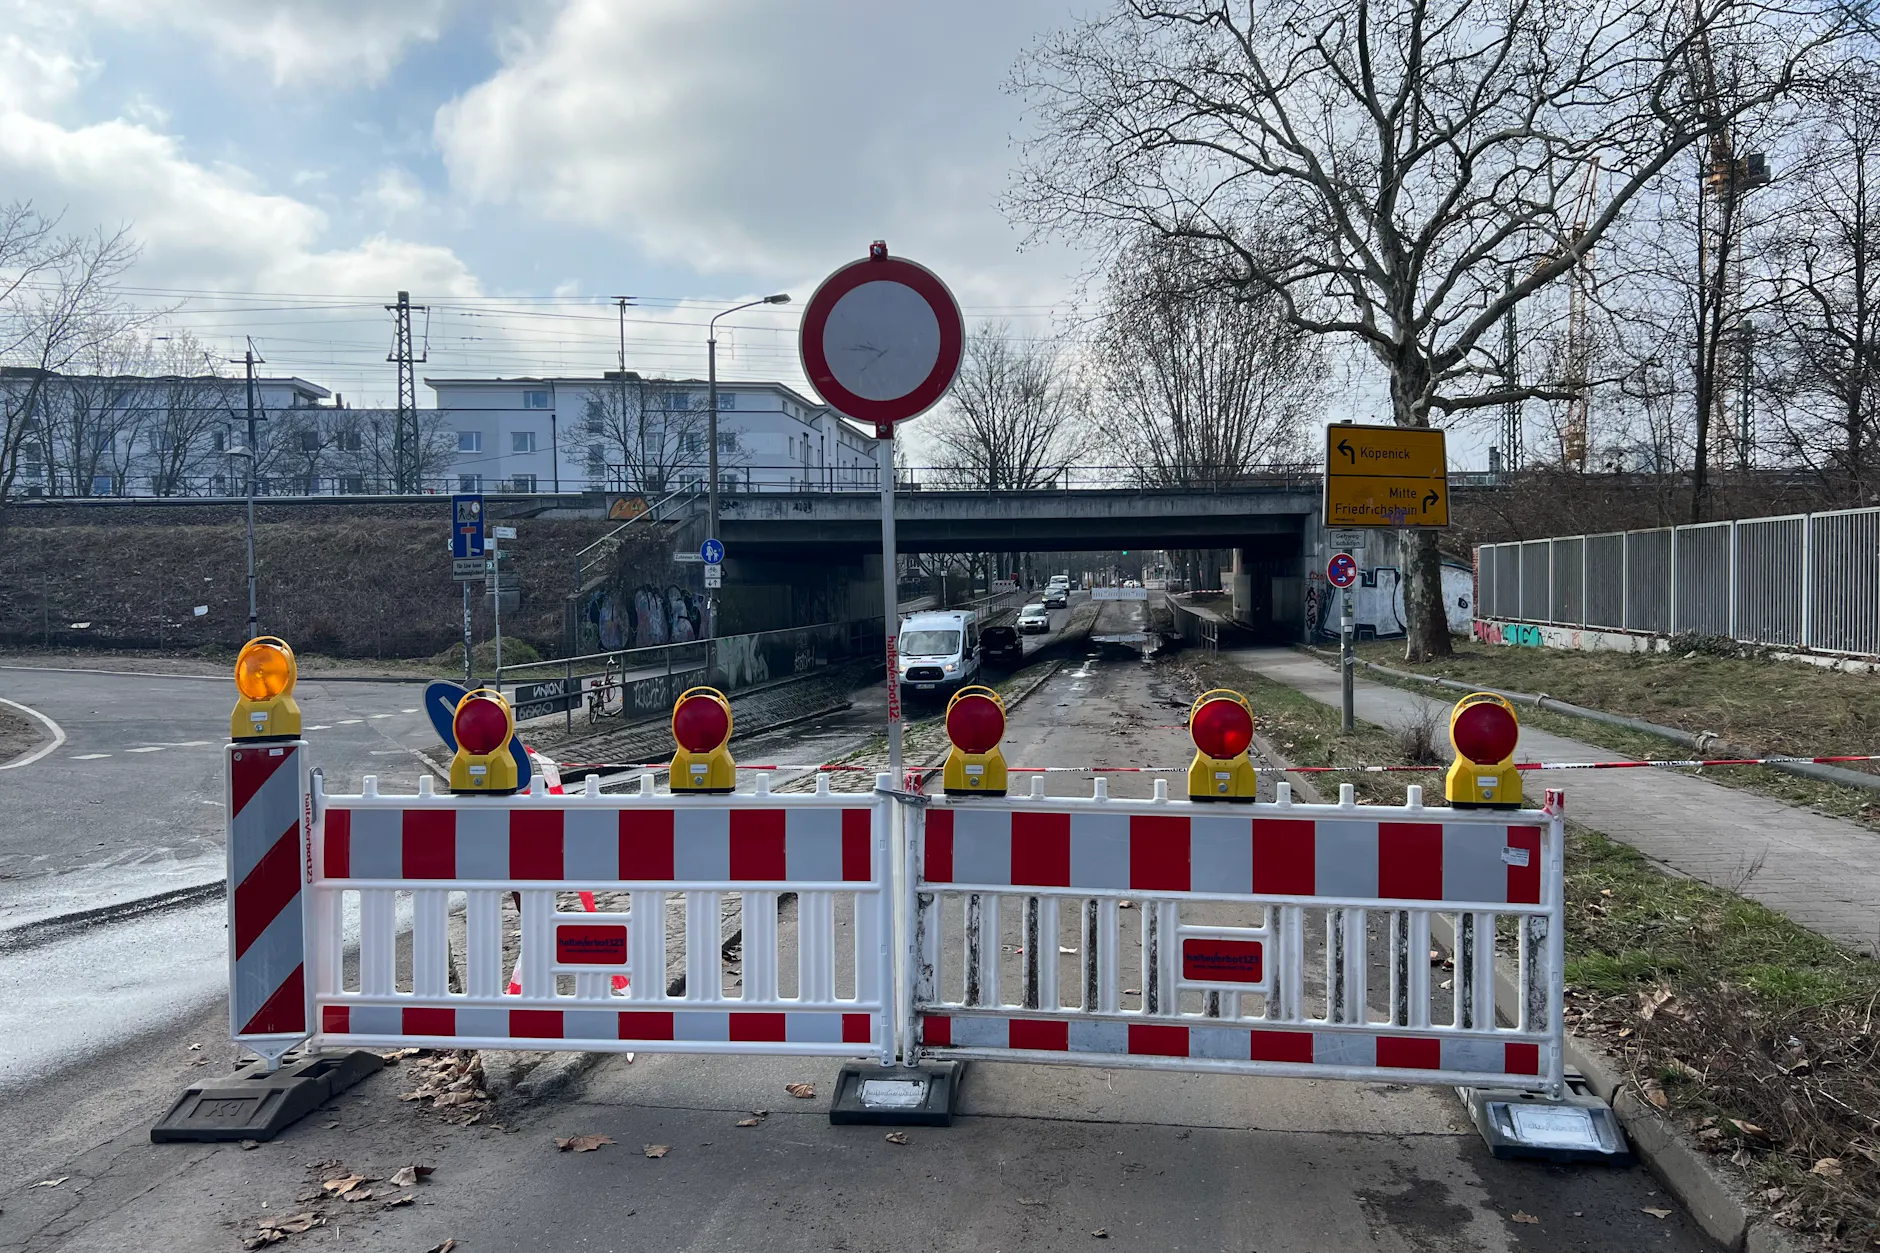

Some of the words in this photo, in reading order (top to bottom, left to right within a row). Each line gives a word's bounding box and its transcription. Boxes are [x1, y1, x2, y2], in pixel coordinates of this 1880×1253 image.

[1360, 446, 1410, 460] Köpenick
[1389, 487, 1417, 499] Mitte
[1335, 502, 1418, 516] Friedrichshain
[533, 679, 565, 698] UNION!
[304, 792, 313, 885] halteverbot123
[559, 936, 624, 948] halteverbot123
[1186, 951, 1260, 964] halteverbot123
